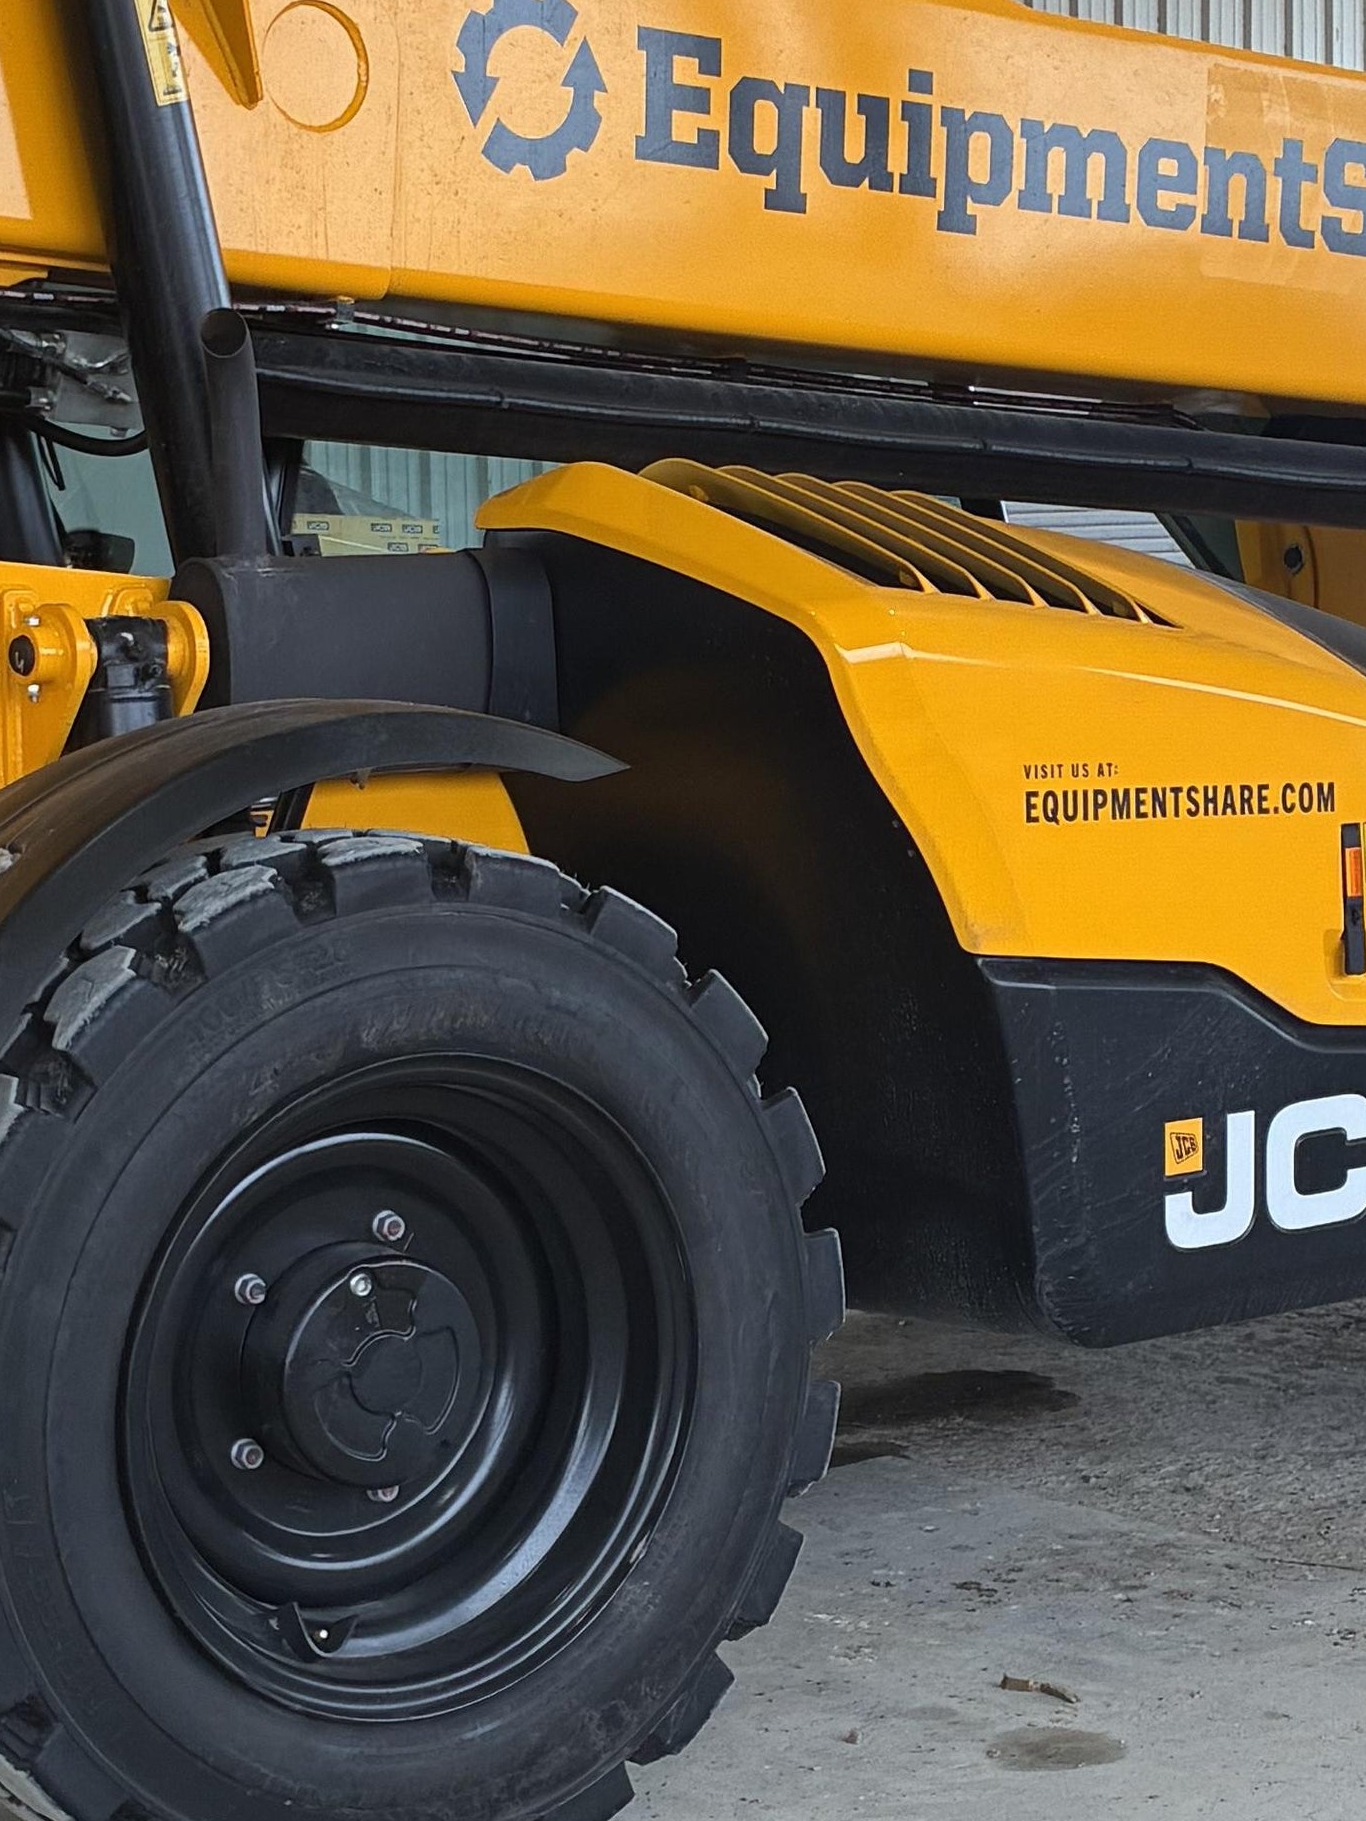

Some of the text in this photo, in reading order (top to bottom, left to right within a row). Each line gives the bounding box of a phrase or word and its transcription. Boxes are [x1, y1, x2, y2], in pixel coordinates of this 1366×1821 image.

[1024, 762, 1120, 779] VISIT US AT:
[1025, 781, 1336, 826] EQUIPMENTSHARE.COM
[1175, 1135, 1197, 1160] JCB
